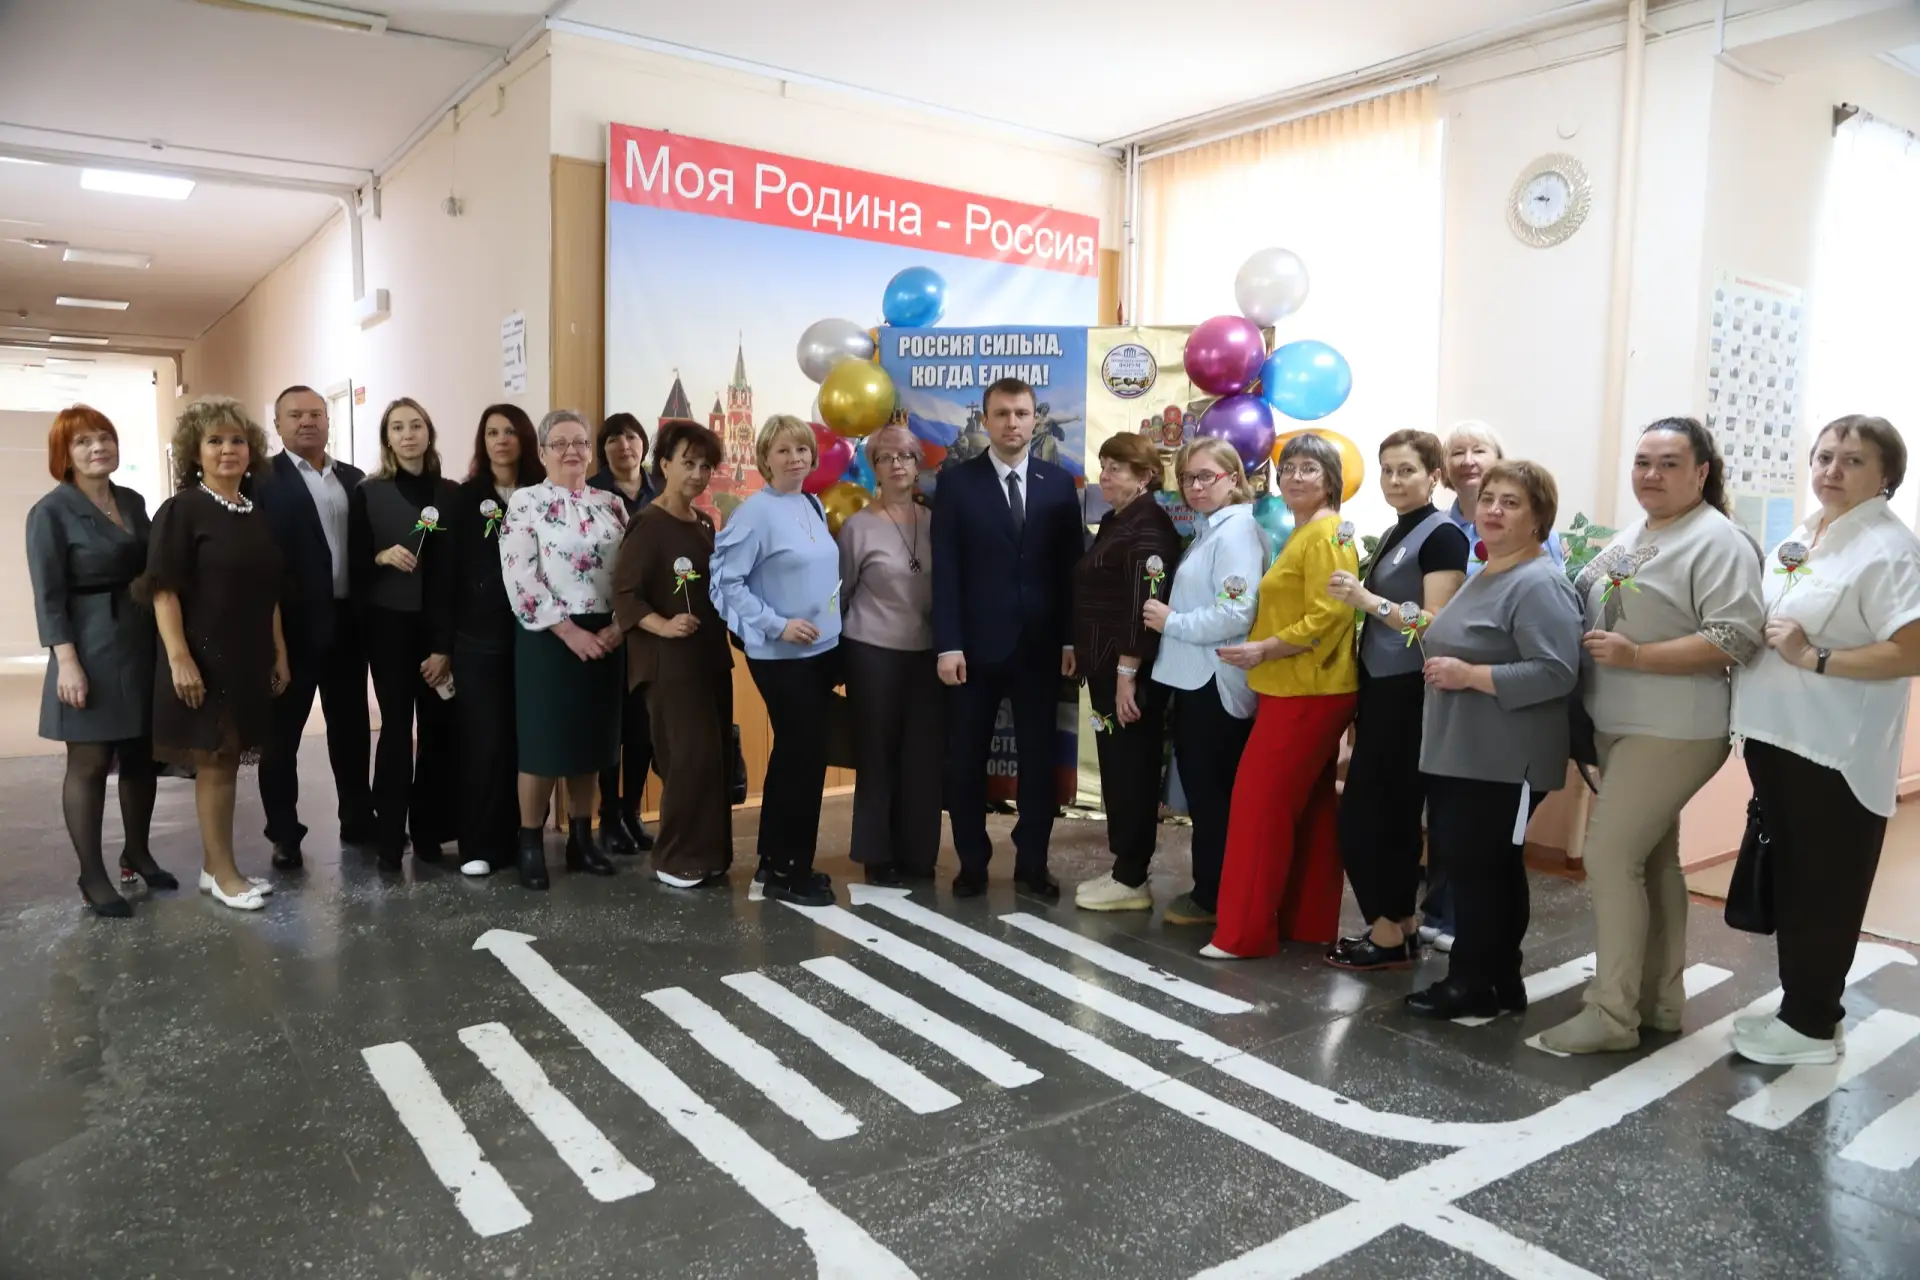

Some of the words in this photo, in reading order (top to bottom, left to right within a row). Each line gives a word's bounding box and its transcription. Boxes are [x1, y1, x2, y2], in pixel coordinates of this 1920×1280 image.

[625, 139, 734, 205] Моя
[755, 163, 922, 237] Родина
[936, 220, 951, 229] -
[965, 203, 1094, 266] Россия
[899, 334, 975, 357] РОССИЯ
[979, 333, 1063, 357] СИЛЬНА,
[911, 365, 974, 389] КОГДА
[978, 364, 1049, 387] ЕДИНА!
[986, 758, 1018, 778] ОСС
